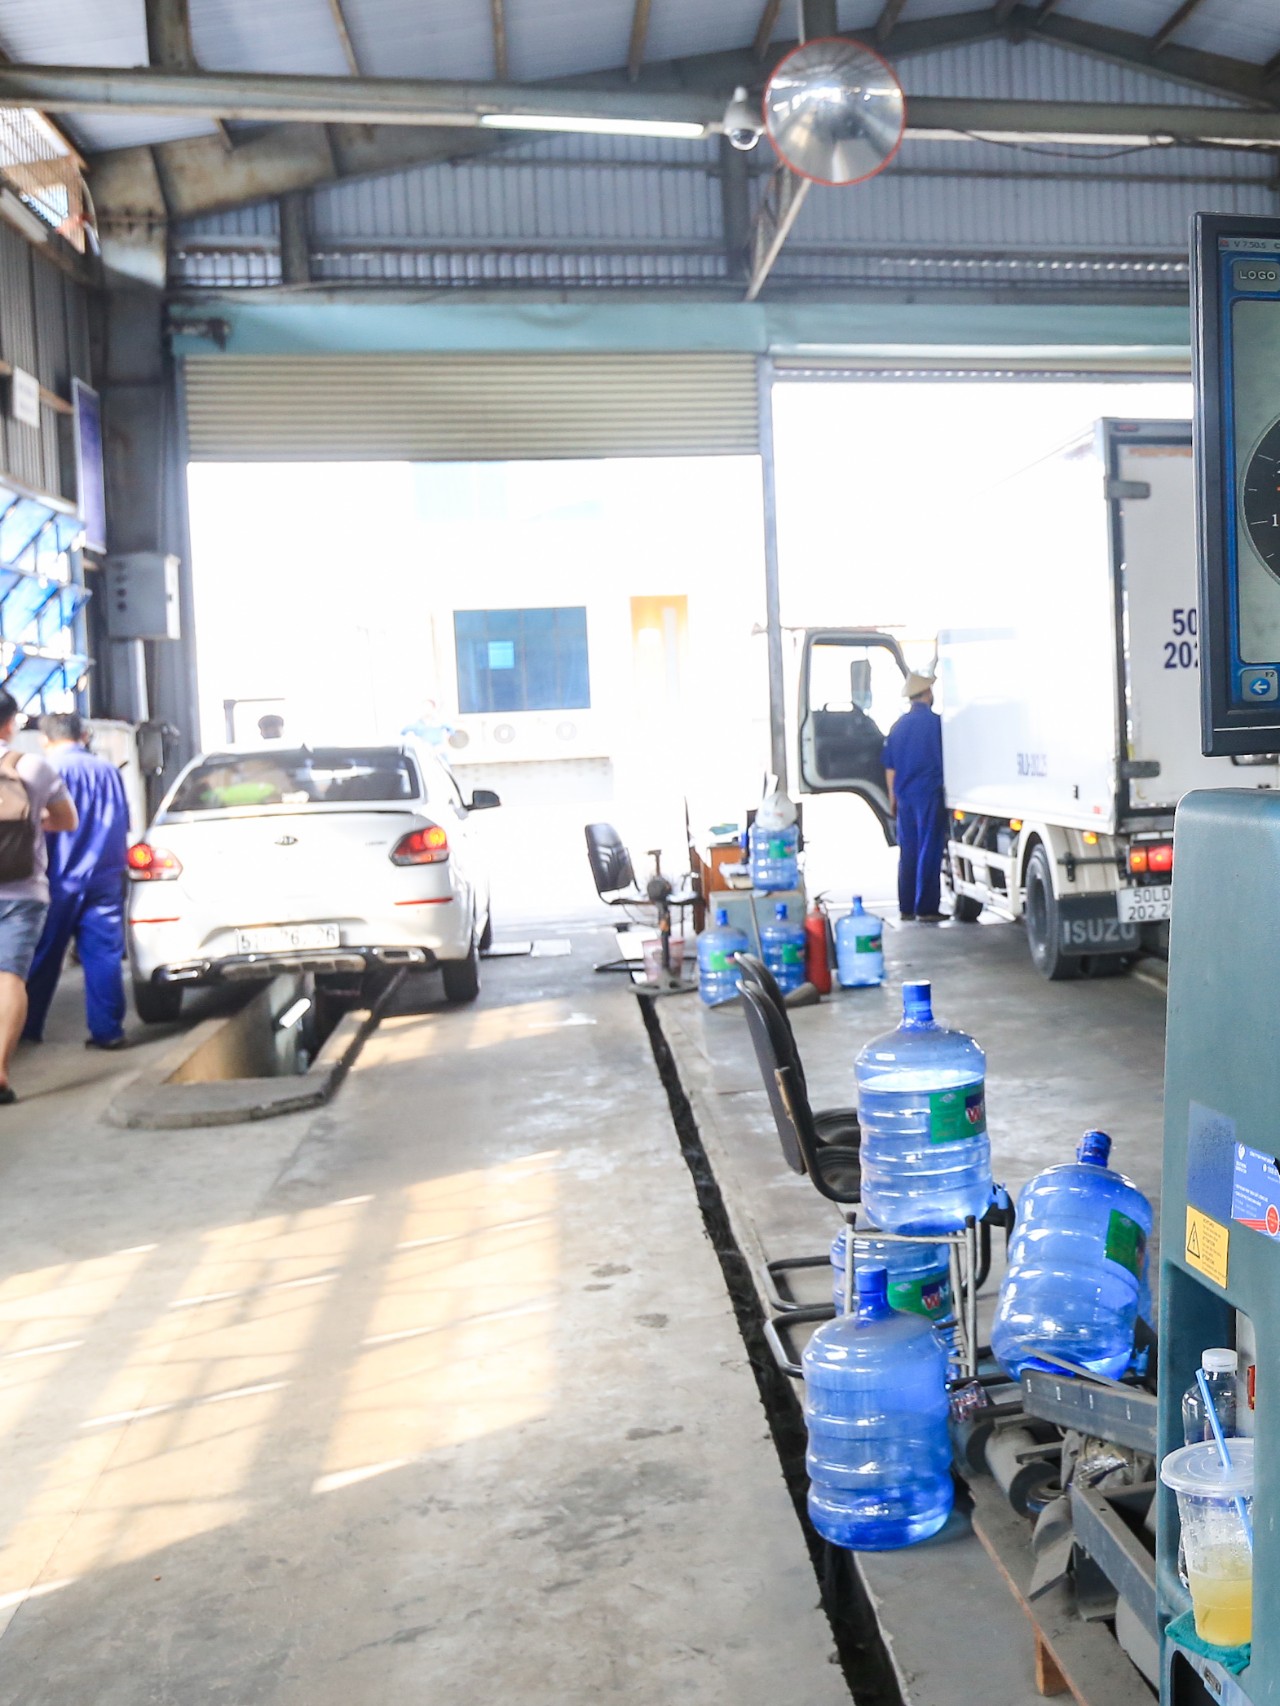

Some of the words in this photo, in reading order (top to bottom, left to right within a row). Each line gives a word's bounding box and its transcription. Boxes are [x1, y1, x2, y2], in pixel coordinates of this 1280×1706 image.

[1239, 270, 1276, 280] LOGO
[1272, 514, 1279, 527] 1
[1133, 887, 1171, 904] 50LD
[1063, 918, 1136, 944] ISUZU
